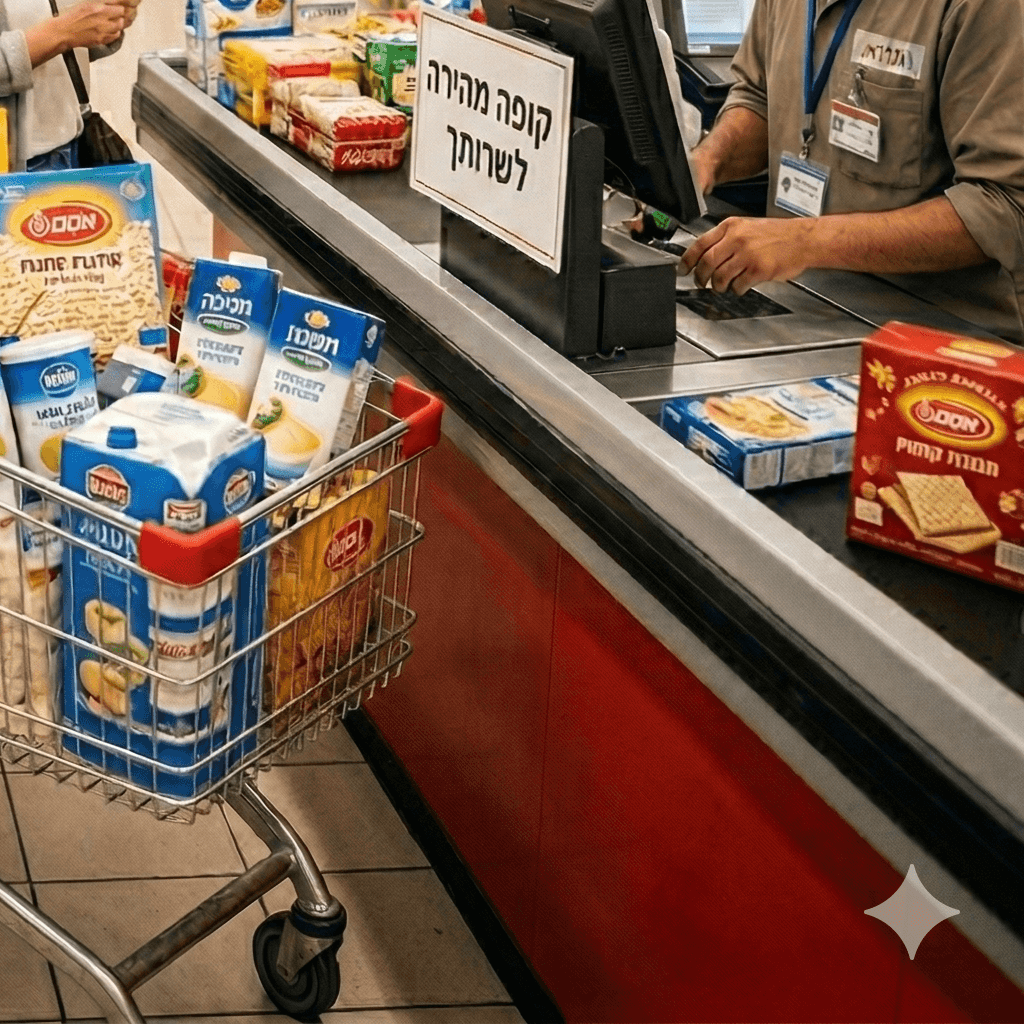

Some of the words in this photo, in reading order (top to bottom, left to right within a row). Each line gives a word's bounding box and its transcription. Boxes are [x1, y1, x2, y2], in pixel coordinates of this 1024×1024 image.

[427, 59, 490, 115] מהירה
[496, 88, 553, 149] קופה
[447, 124, 529, 192] לשרותך
